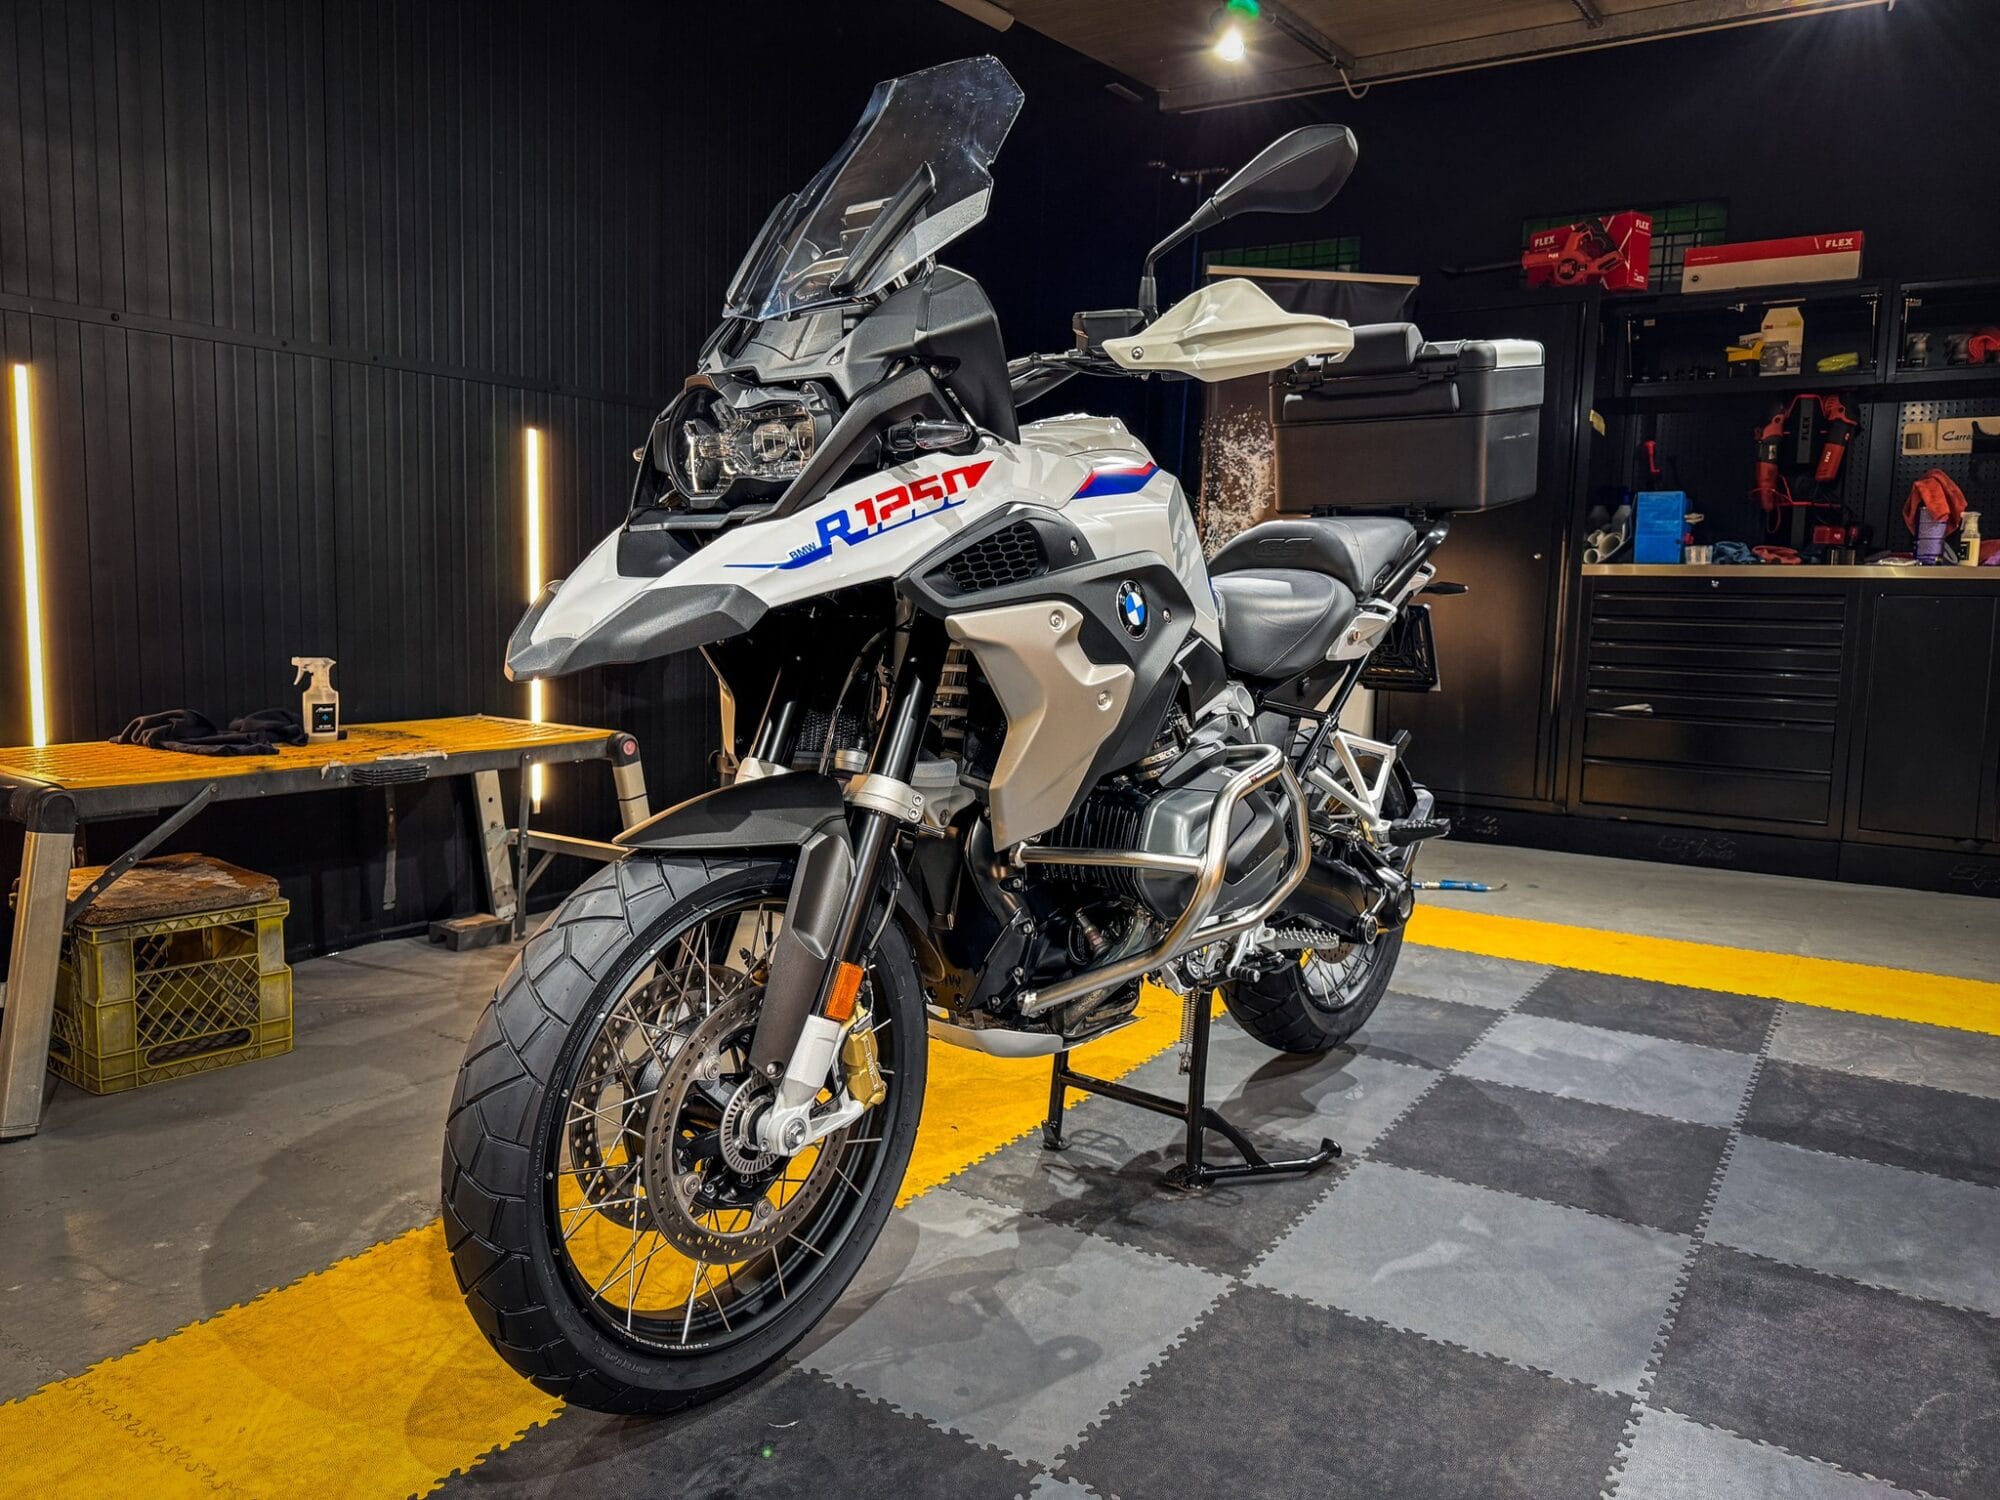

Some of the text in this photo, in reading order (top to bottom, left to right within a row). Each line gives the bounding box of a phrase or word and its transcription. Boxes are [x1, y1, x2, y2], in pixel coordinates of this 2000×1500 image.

[1636, 219, 1649, 231] FLEX
[1535, 235, 1555, 247] FLEX
[1825, 238, 1853, 248] FLEX
[1801, 416, 1811, 441] FLEX
[1942, 431, 1973, 441] Carro
[789, 542, 817, 560] BMW
